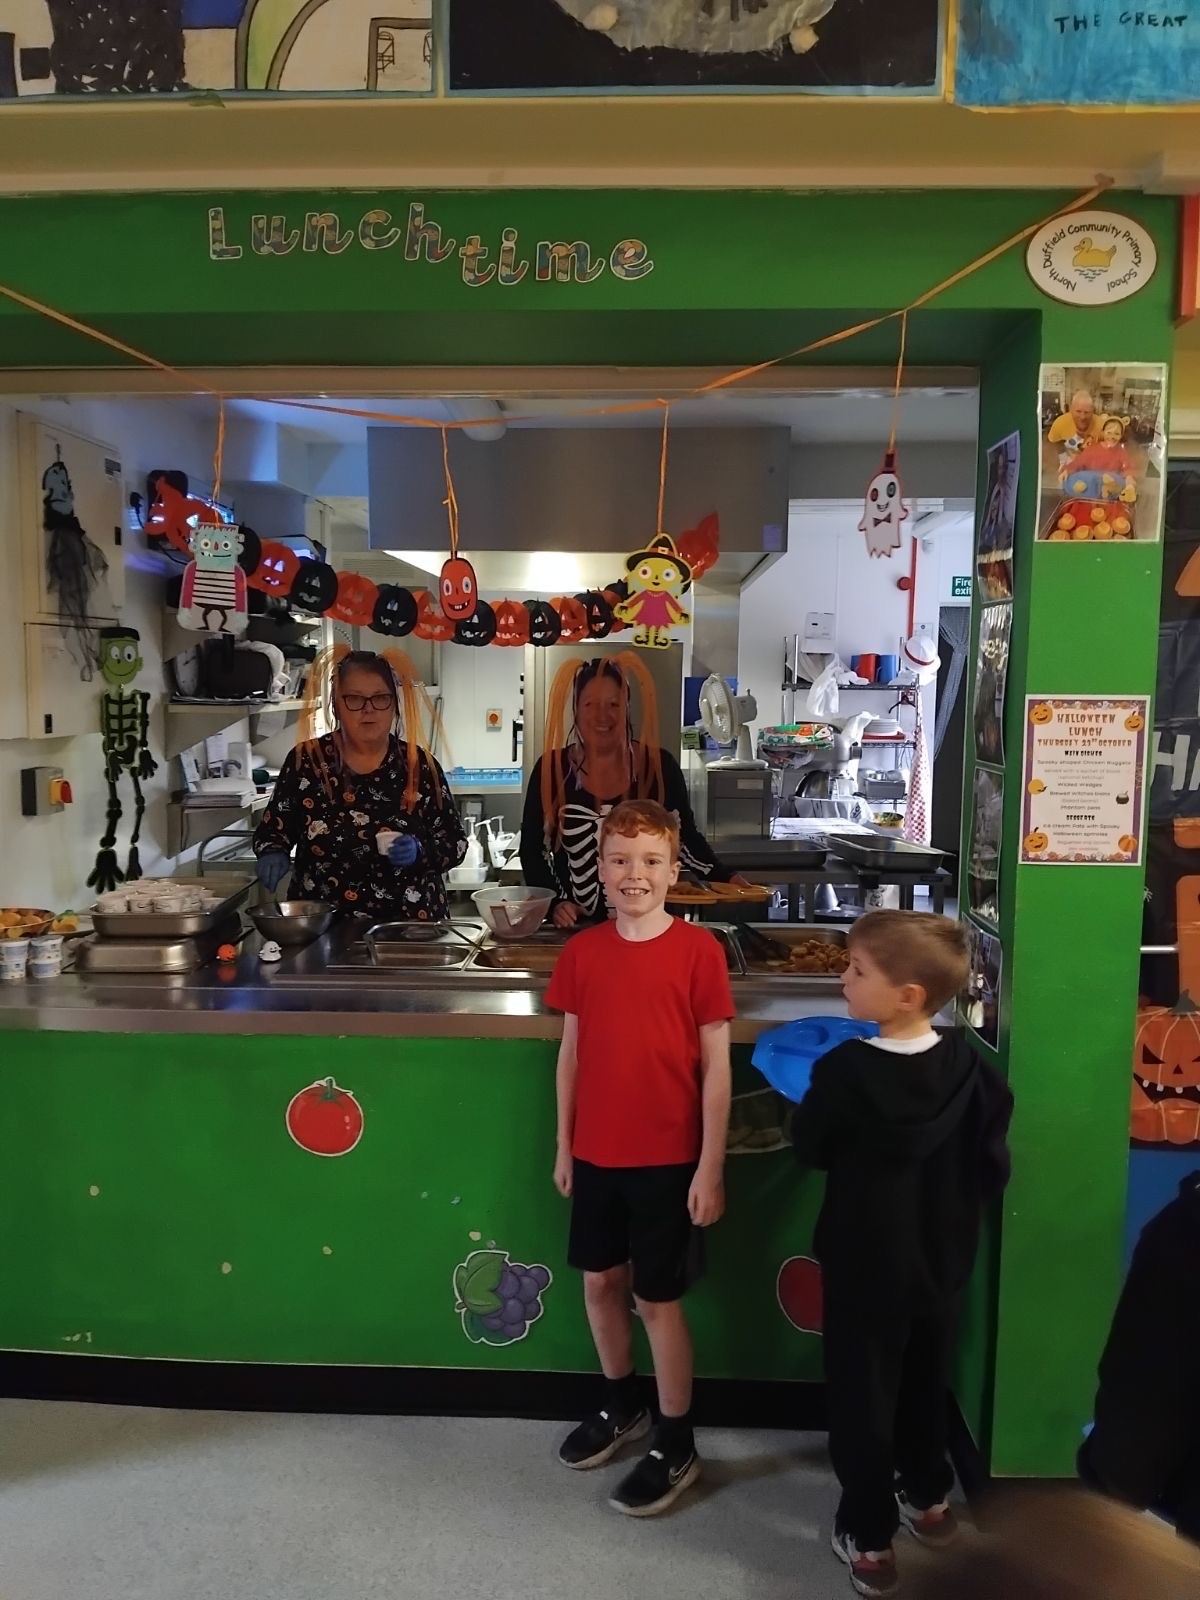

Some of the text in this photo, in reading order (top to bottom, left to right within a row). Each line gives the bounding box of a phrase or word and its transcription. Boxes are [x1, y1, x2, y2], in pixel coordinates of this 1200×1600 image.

[1054, 11, 1188, 33] THE GREAT
[1042, 223, 1142, 292] North Duffield Community Primary School
[1057, 713, 1116, 724] HALLOWEEN
[1069, 727, 1103, 736] LUNCH
[1037, 739, 1078, 747] THURSDAY
[1098, 739, 1133, 747] OCTOBER
